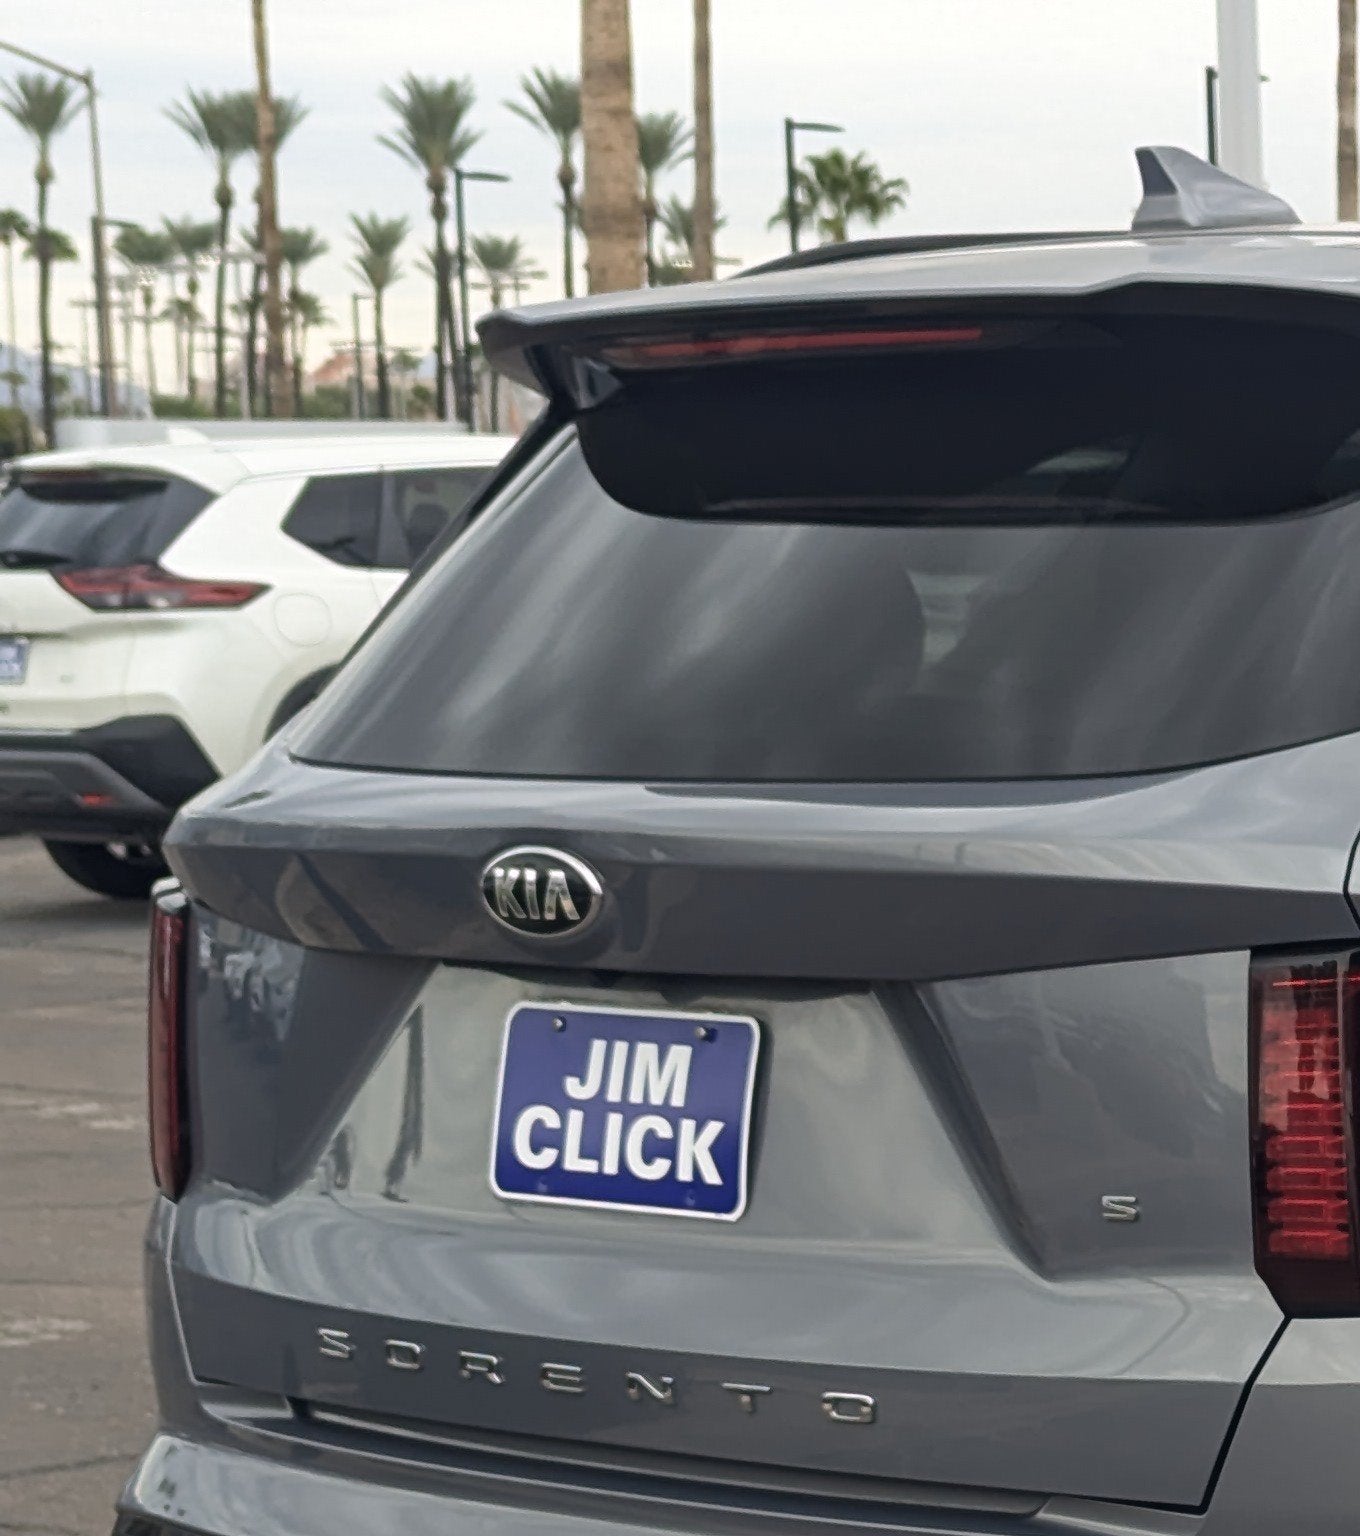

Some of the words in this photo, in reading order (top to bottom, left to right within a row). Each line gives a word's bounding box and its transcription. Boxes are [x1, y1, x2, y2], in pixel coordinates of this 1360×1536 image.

[493, 867, 581, 921] KIA
[563, 1038, 694, 1108] JIM
[513, 1104, 727, 1187] CLICK
[1101, 1194, 1140, 1223] S
[317, 1326, 878, 1425] SORENTO
